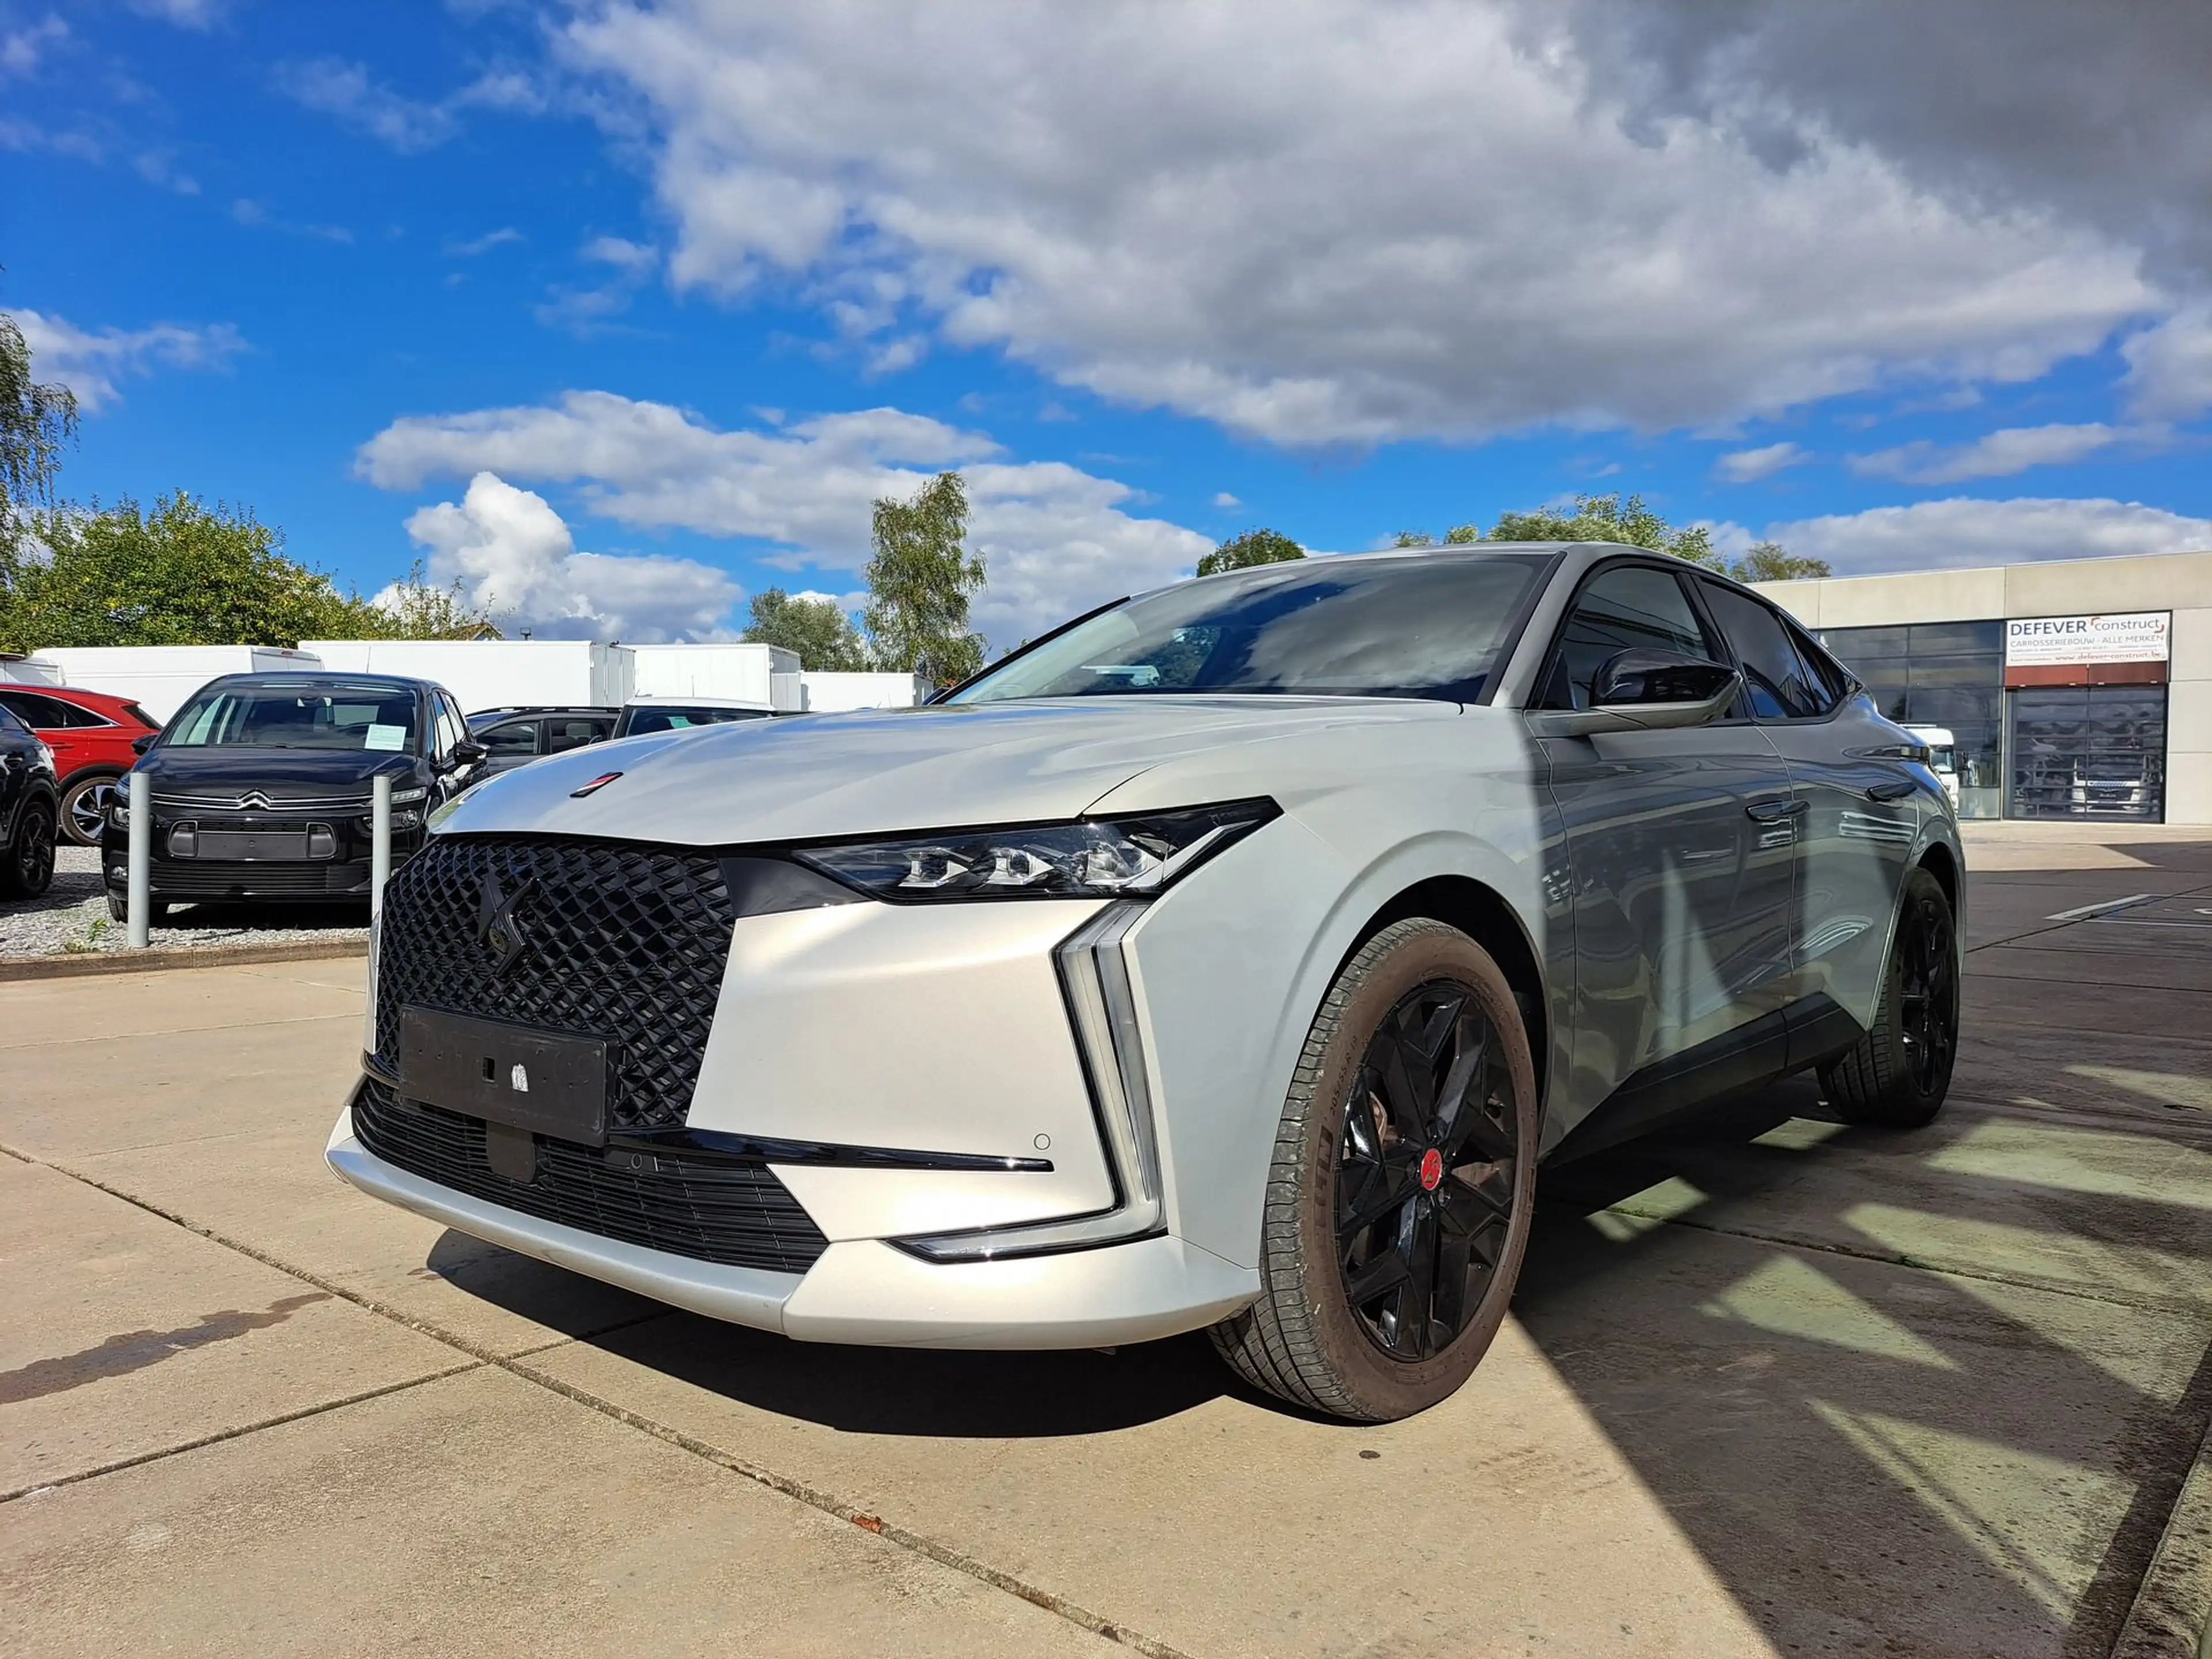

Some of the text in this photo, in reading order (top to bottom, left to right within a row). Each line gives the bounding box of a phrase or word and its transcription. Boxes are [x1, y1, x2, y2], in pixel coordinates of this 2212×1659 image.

[2010, 619, 2160, 635] DEFEVER construct
[2010, 638, 2095, 647] CARROSSERIEBOUW
[2102, 636, 2123, 644] ALLE
[2125, 634, 2164, 643] MERKEN
